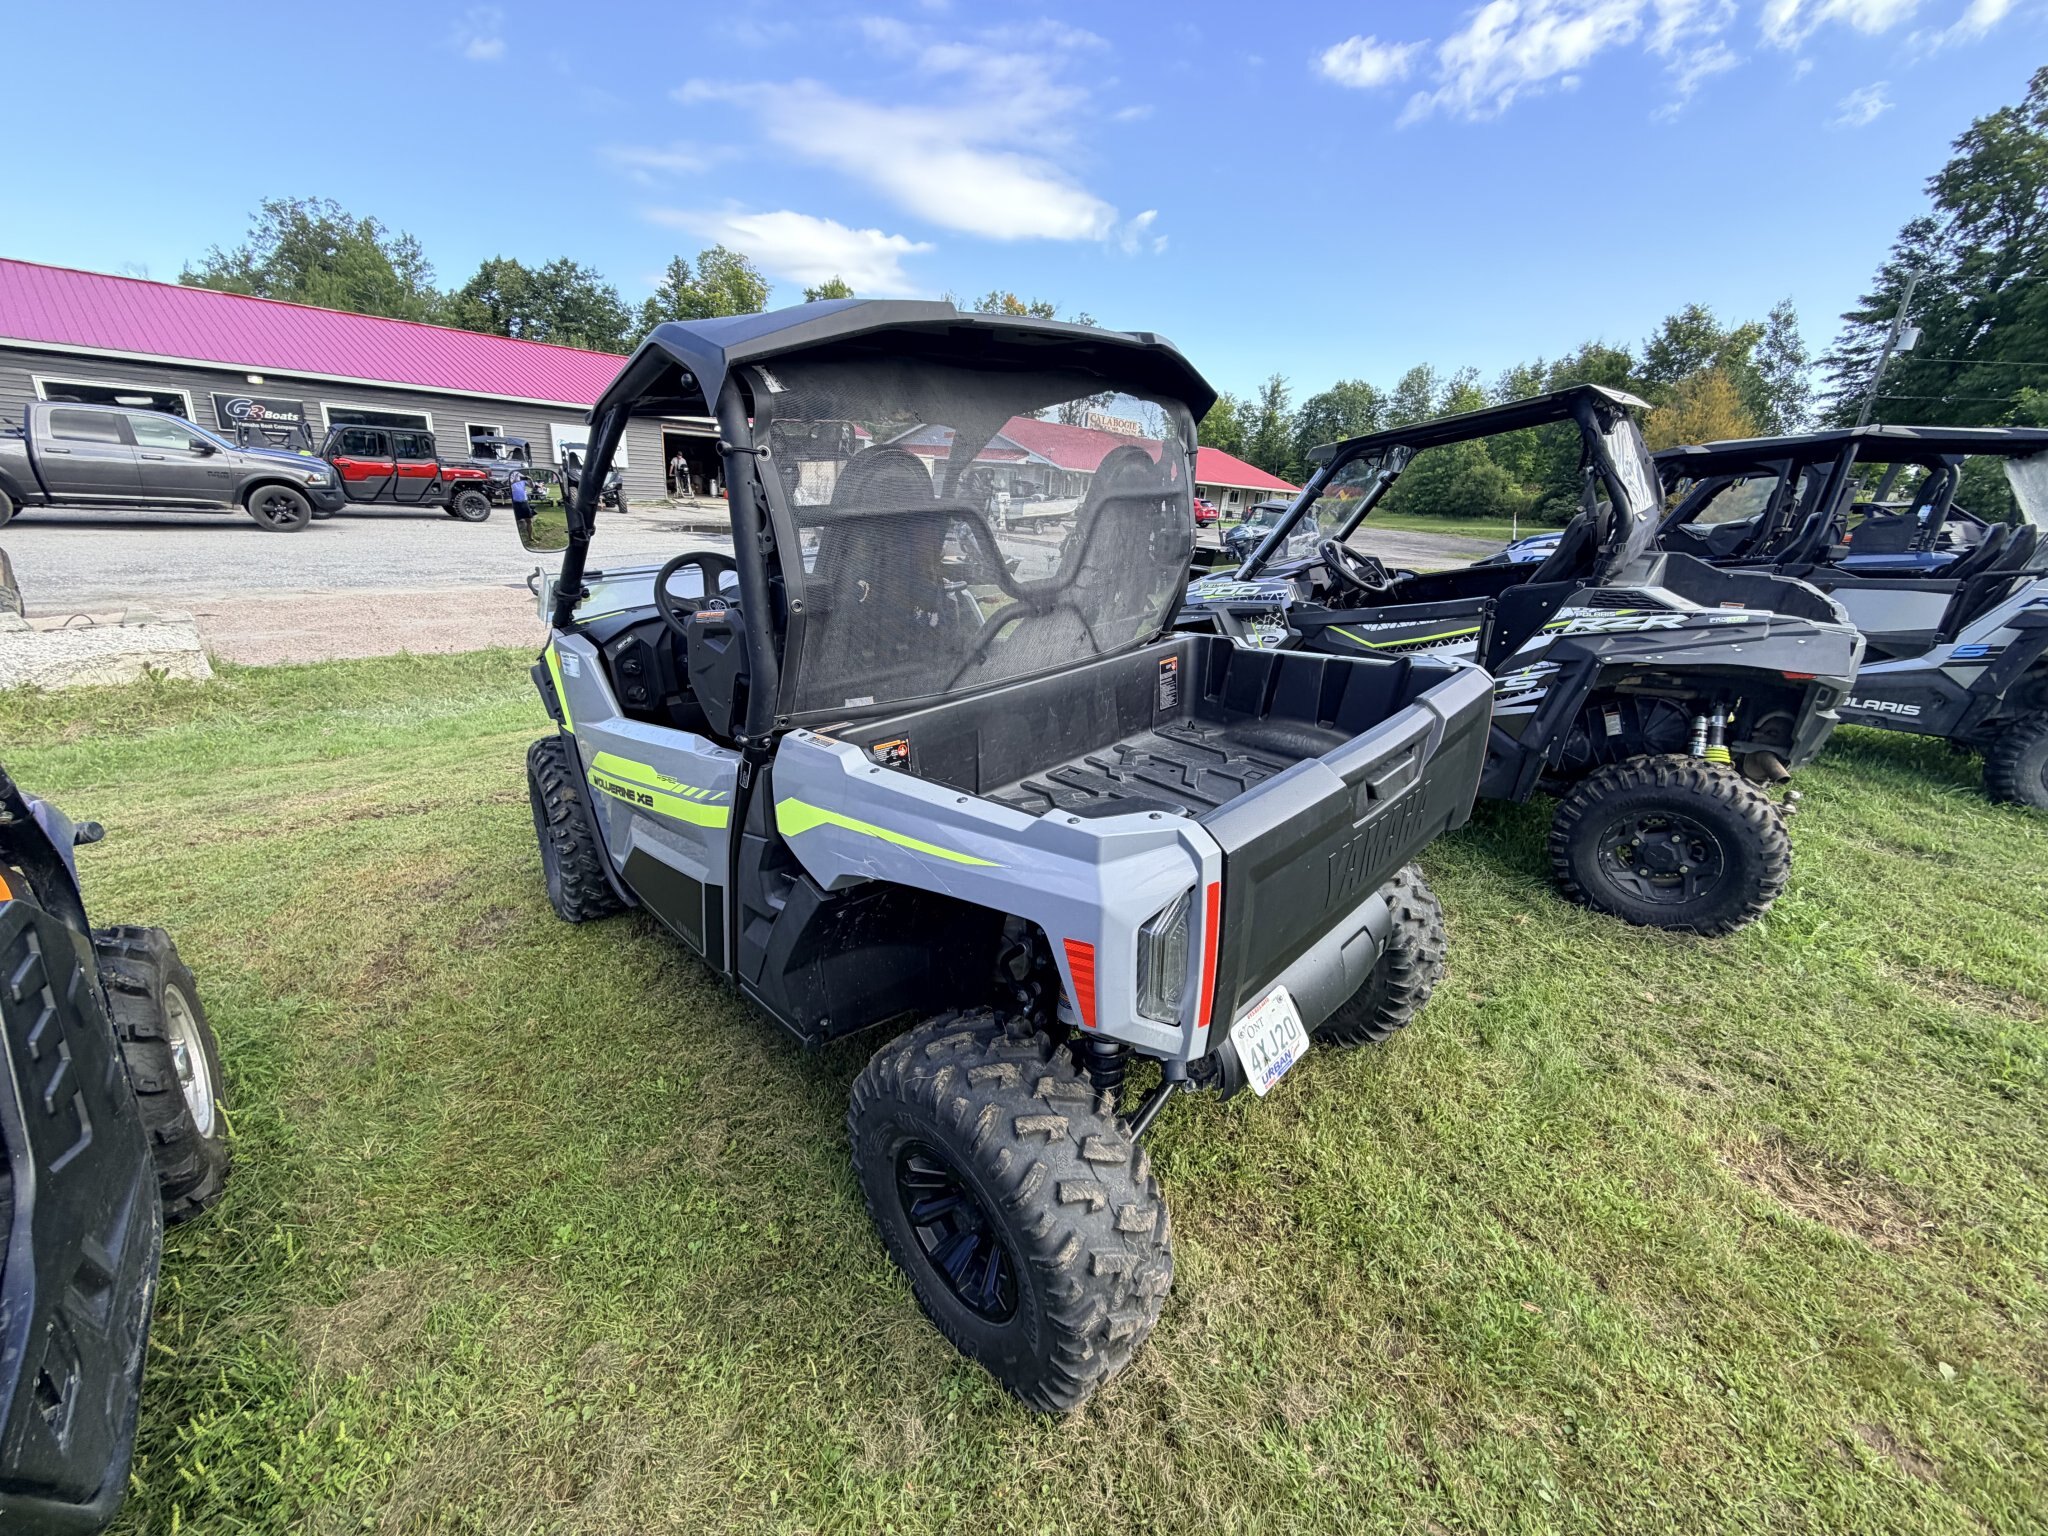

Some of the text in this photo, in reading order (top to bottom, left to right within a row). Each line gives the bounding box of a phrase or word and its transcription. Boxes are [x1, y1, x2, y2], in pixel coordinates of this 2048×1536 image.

[225, 398, 299, 421] G3 Boats
[1090, 414, 1137, 431] CALABOGIE
[1562, 614, 1690, 634] RZR
[1574, 610, 1617, 618] POLARIS
[1843, 696, 1921, 716] LARIS
[593, 775, 654, 808] WOLVERINE X2
[1261, 1049, 1293, 1085] URBAN
